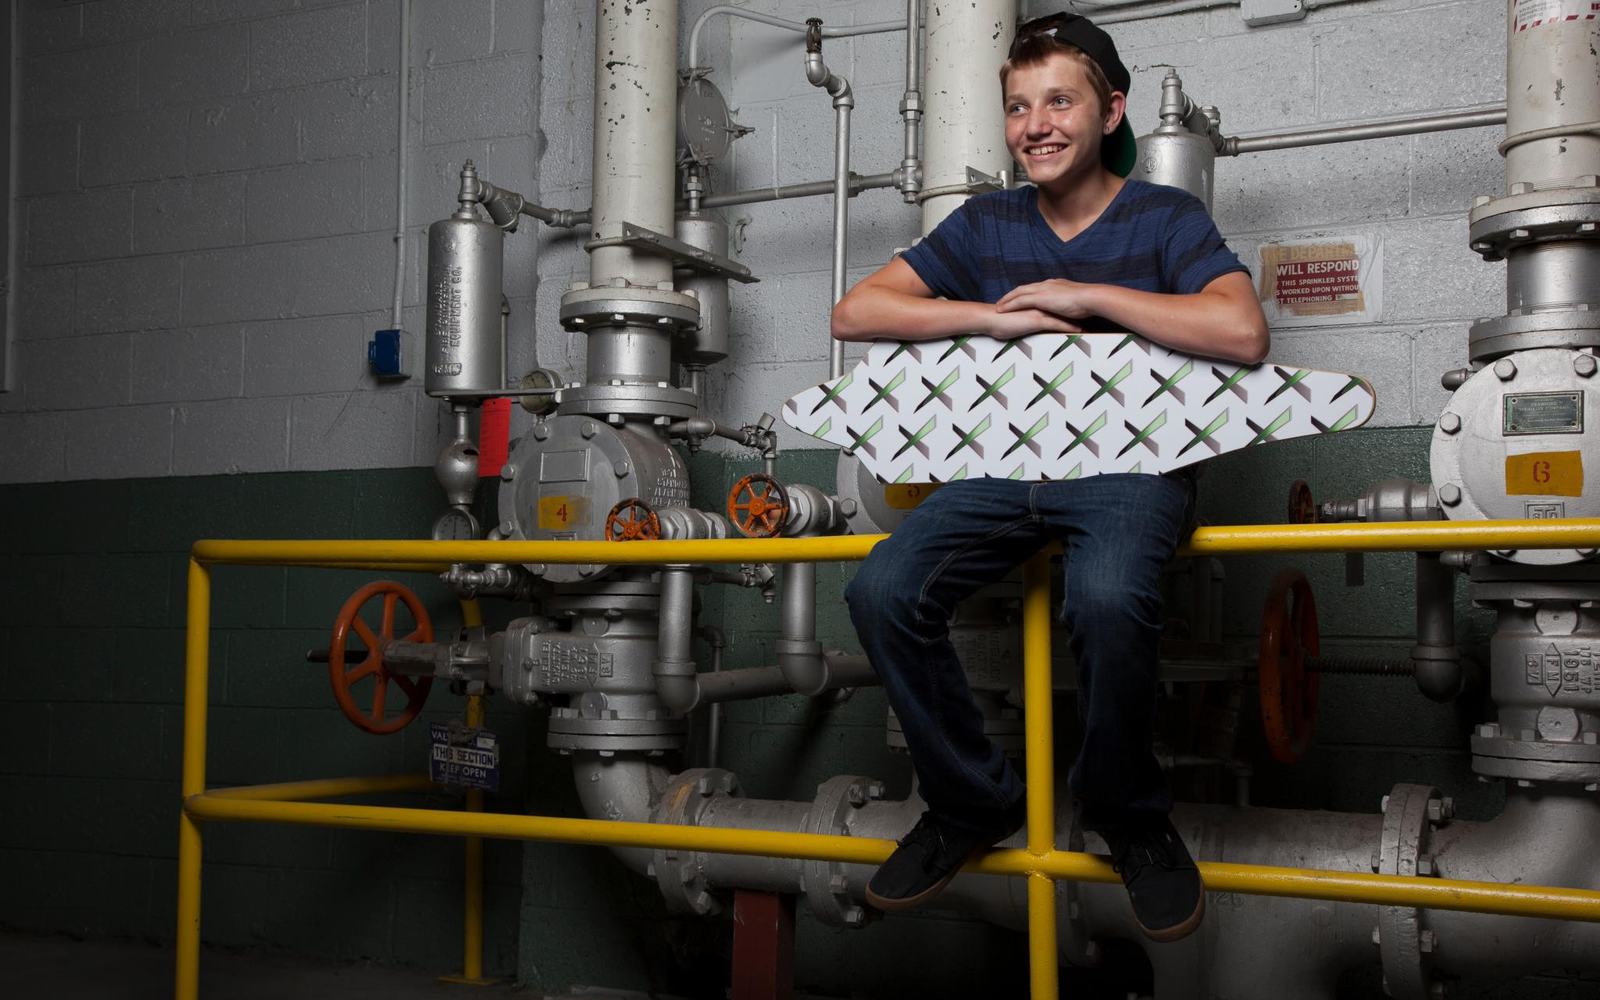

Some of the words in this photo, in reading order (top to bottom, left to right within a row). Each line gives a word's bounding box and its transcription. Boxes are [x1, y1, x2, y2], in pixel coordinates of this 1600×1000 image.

[1276, 264, 1304, 276] WILL
[1307, 259, 1359, 275] RESPOND
[1299, 277, 1335, 286] SPRINKLER
[1282, 288, 1311, 296] WORKED
[1286, 295, 1333, 304] TELEPHONING
[449, 288, 462, 348] EQUIPMENT
[1533, 461, 1551, 483] 6
[556, 503, 567, 522] 4
[1563, 651, 1580, 692] 1951
[457, 750, 493, 766] SECTION
[439, 762, 460, 774] KEP
[462, 766, 487, 778] OPEN
